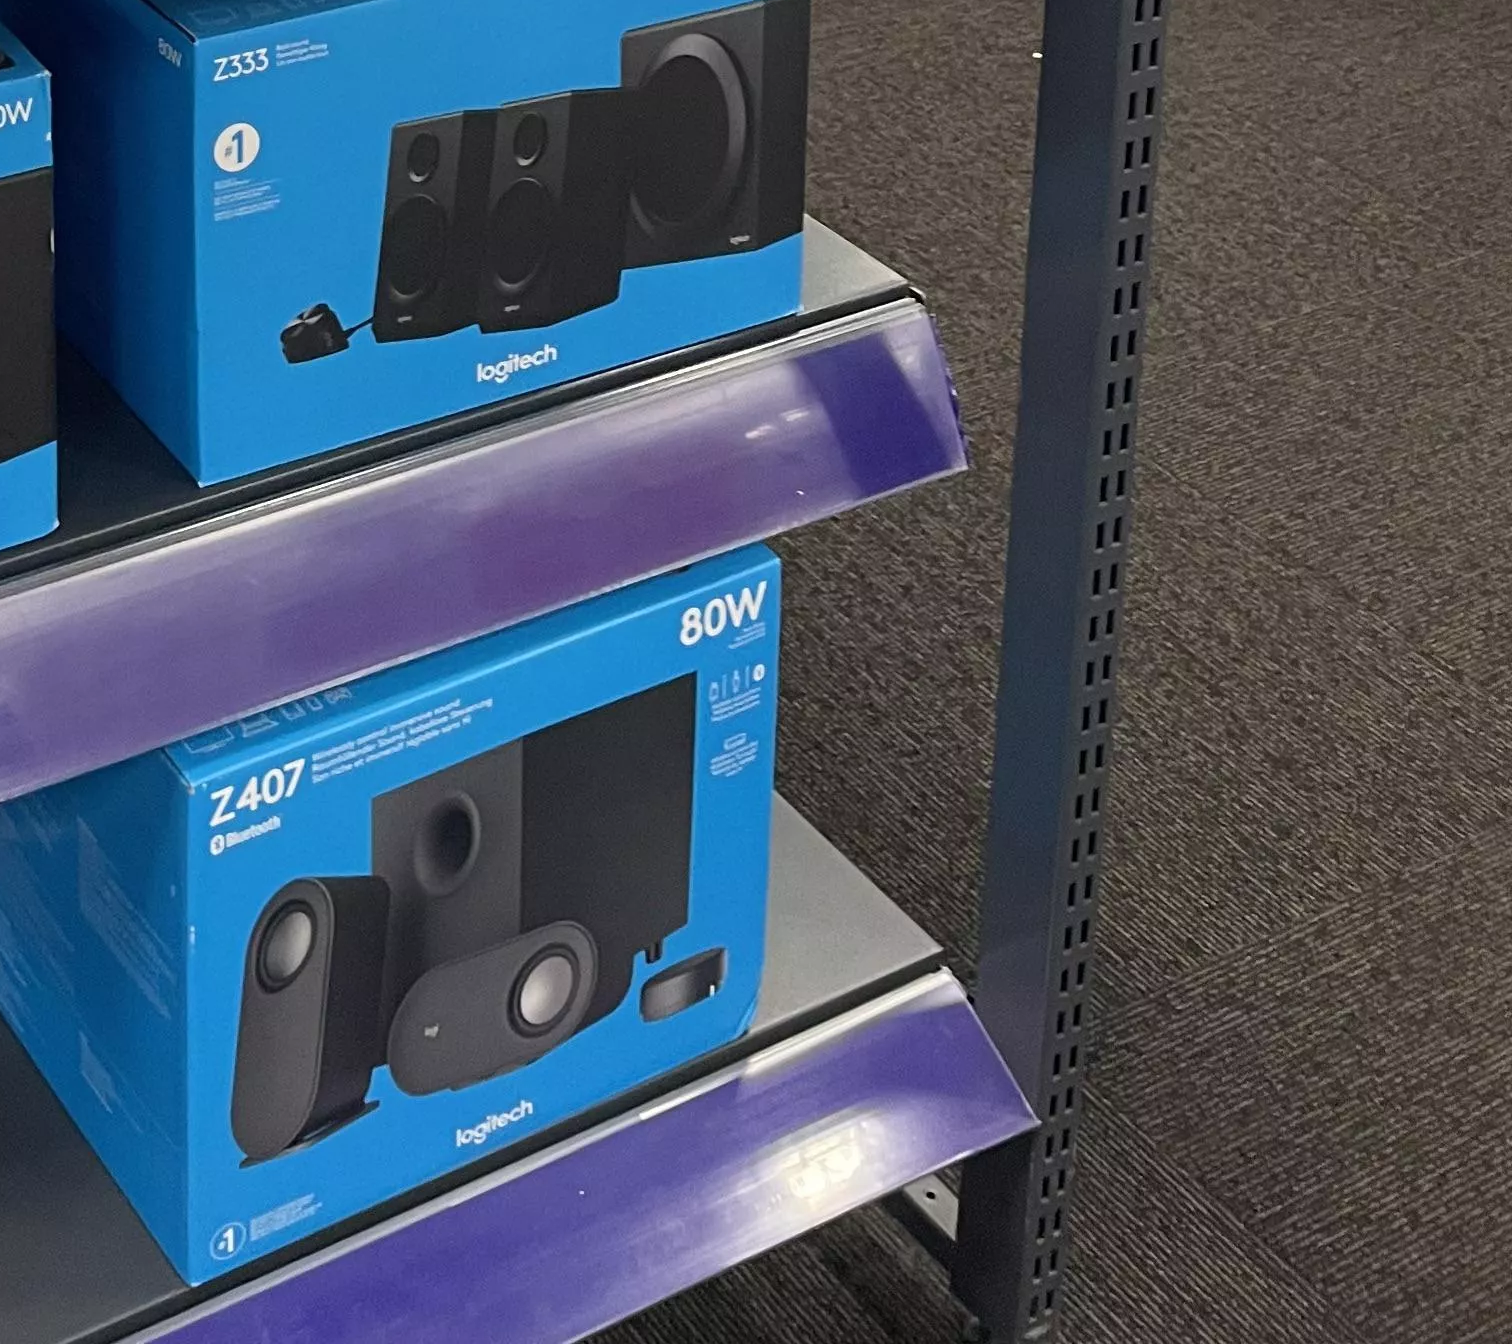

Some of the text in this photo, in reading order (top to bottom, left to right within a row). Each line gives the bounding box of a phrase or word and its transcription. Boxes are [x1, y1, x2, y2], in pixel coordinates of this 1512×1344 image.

[214, 48, 268, 81] Z333
[476, 343, 557, 383] logitech
[680, 581, 767, 645] 80W
[210, 758, 305, 827] Z407
[456, 1099, 533, 1148] logitech
